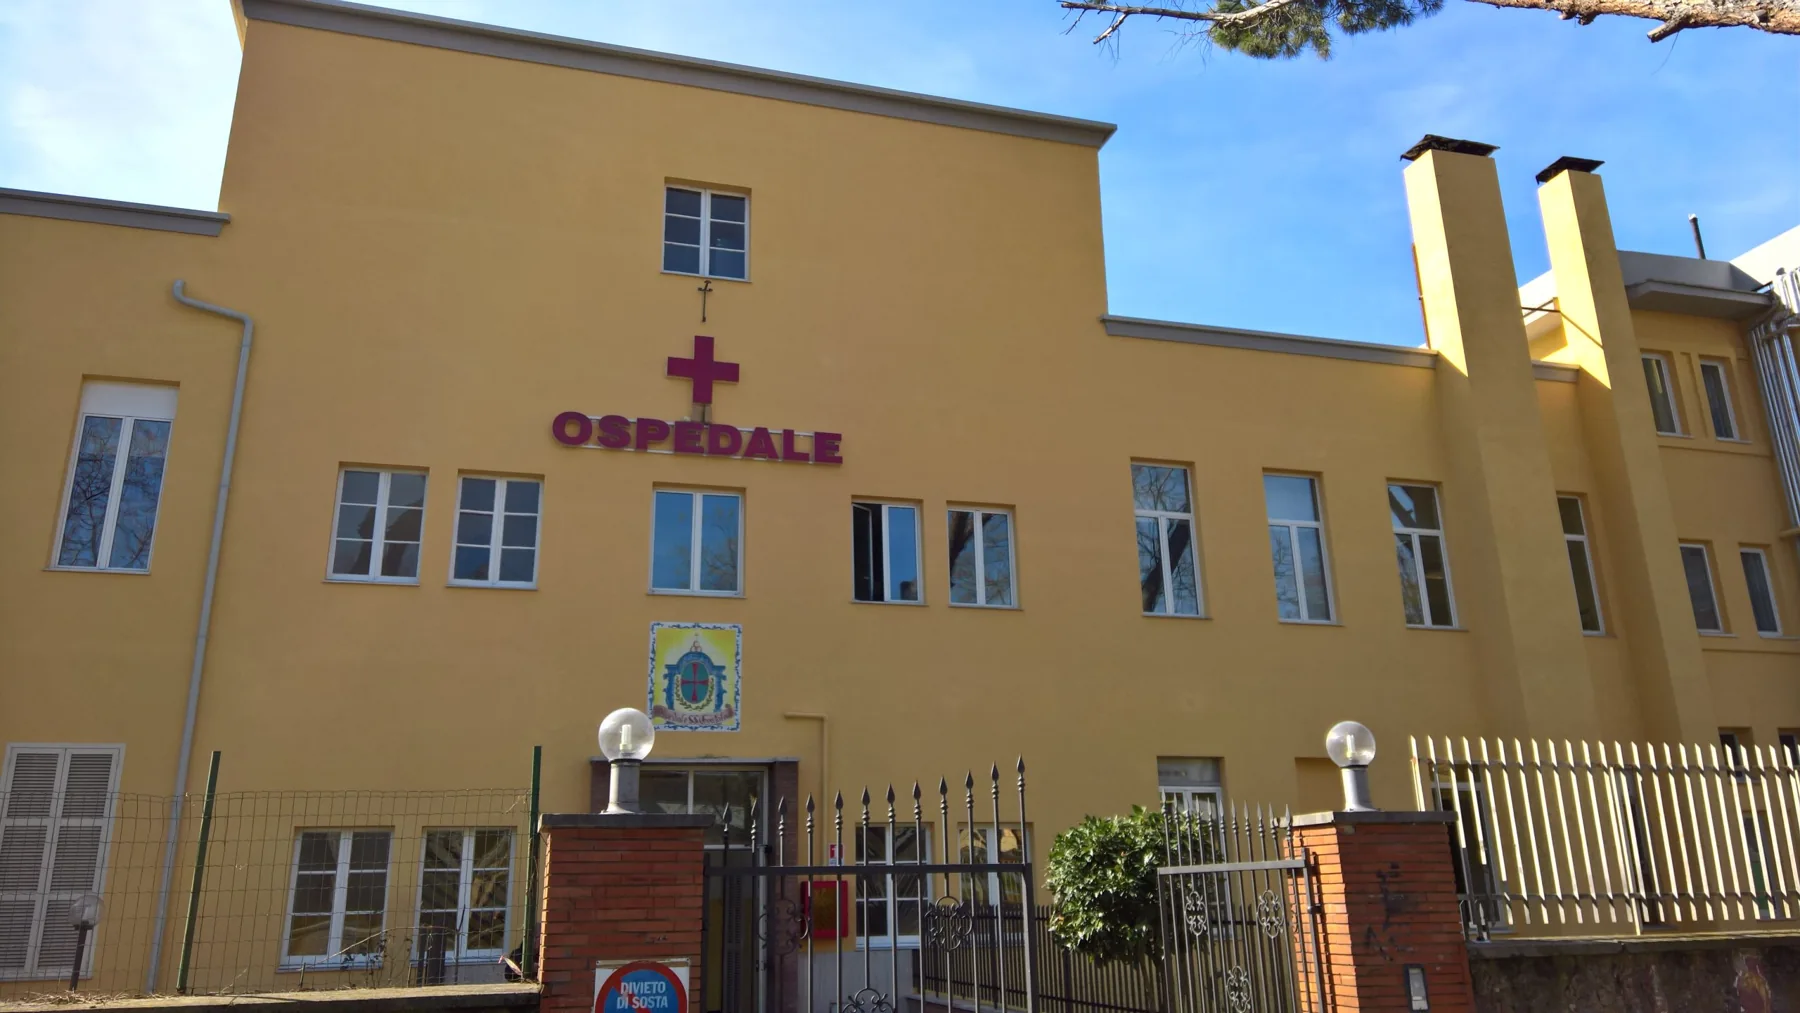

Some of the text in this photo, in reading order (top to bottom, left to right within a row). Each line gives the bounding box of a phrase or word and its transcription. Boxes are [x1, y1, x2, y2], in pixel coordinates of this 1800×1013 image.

[552, 411, 843, 464] OSPEDALE
[620, 981, 666, 994] DIVIETO
[616, 995, 668, 1009] DI SOSTA
